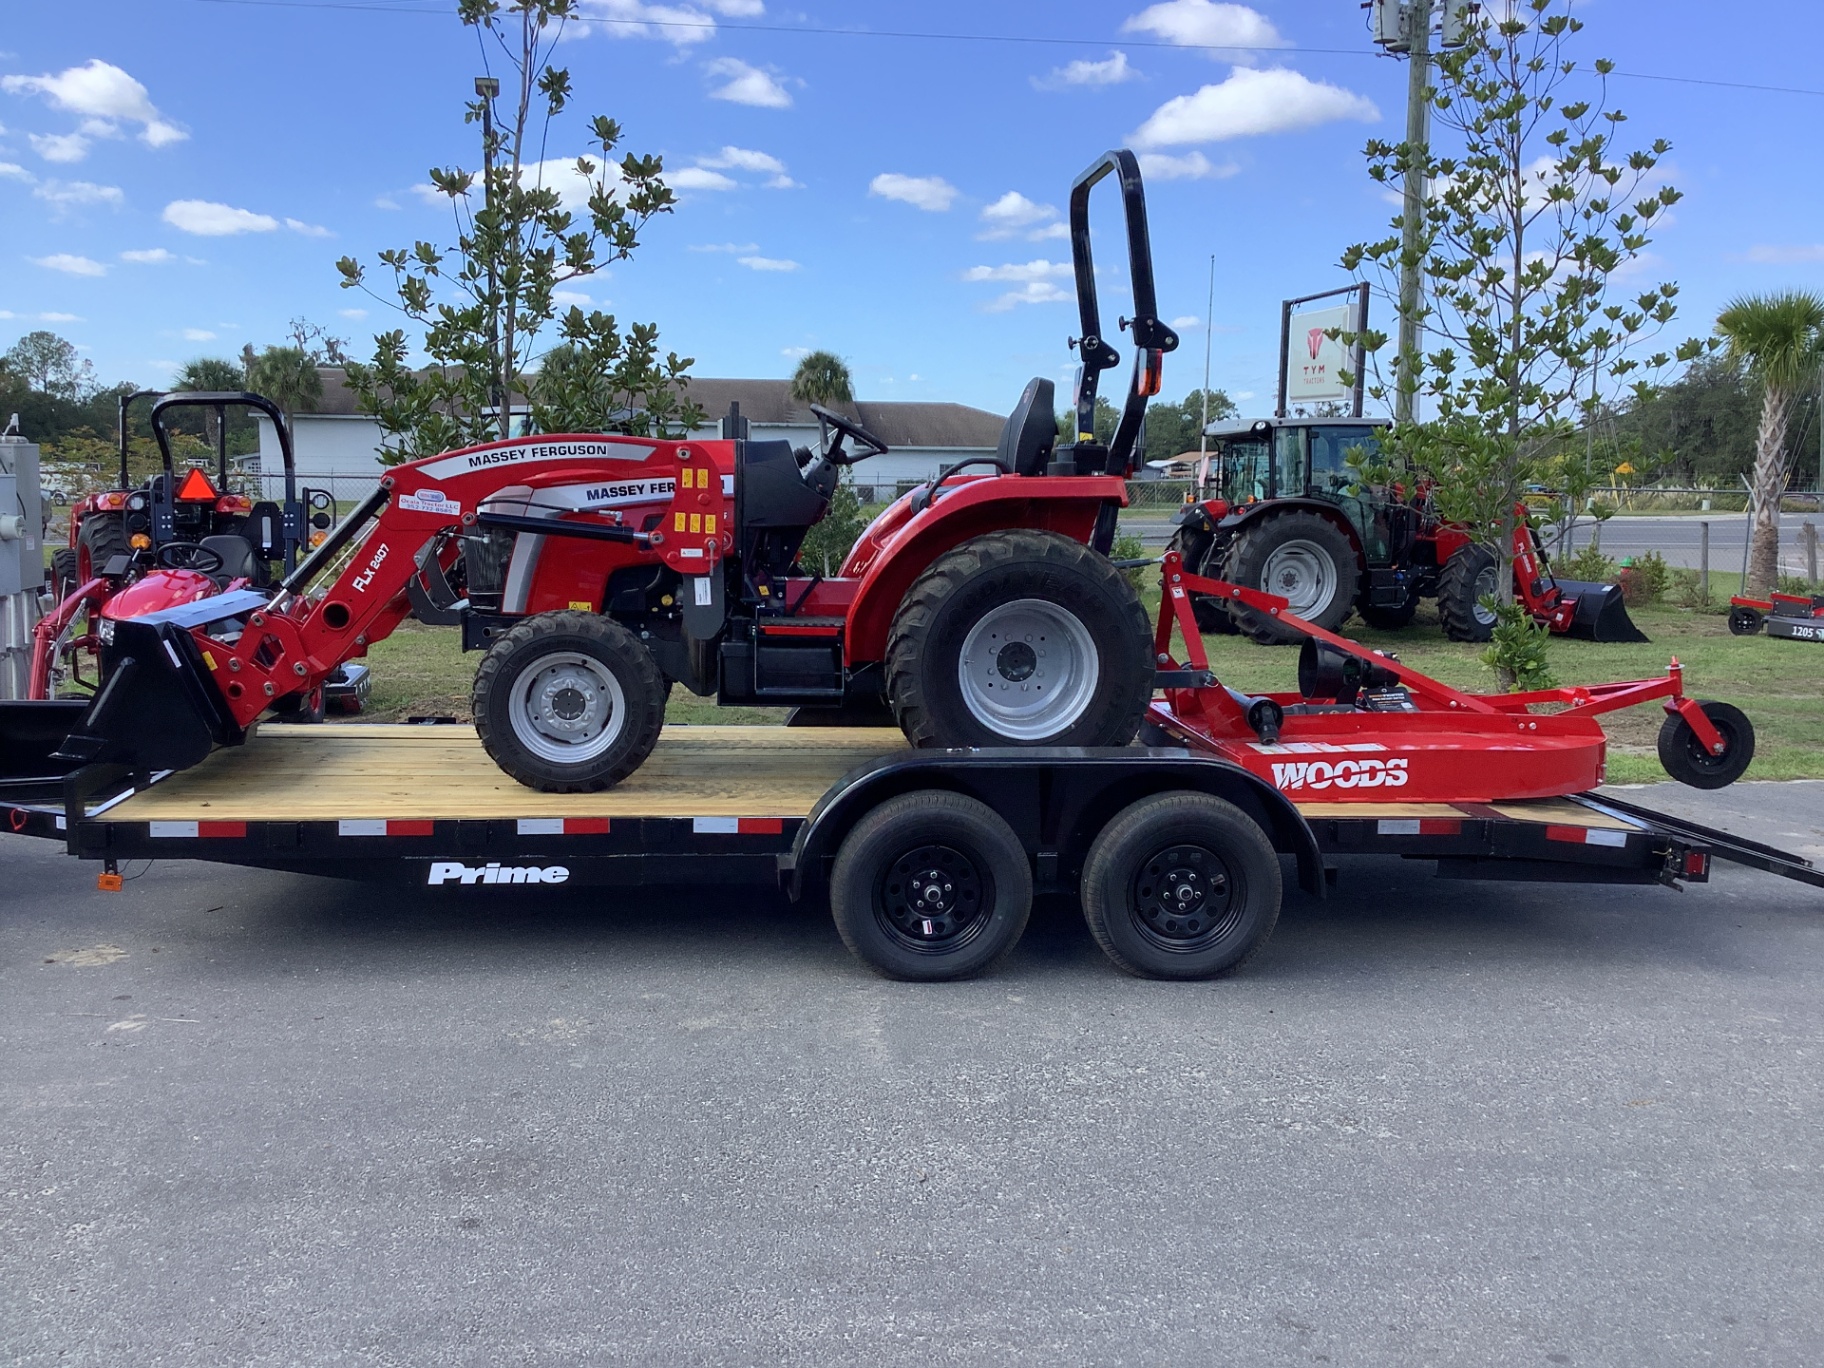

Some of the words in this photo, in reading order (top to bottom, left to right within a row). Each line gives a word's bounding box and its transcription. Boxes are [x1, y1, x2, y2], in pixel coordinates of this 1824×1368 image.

[1303, 364, 1325, 375] TYM
[468, 448, 526, 467] MASSEY
[531, 445, 607, 458] FERGUSON
[586, 484, 645, 501] MASSEY
[650, 482, 676, 494] FER
[421, 500, 444, 508] Tractor
[352, 568, 376, 593] FLX
[369, 543, 389, 570] 2407
[1791, 625, 1815, 638] 1205
[1271, 758, 1409, 790] WOODS
[427, 862, 570, 885] Prime
